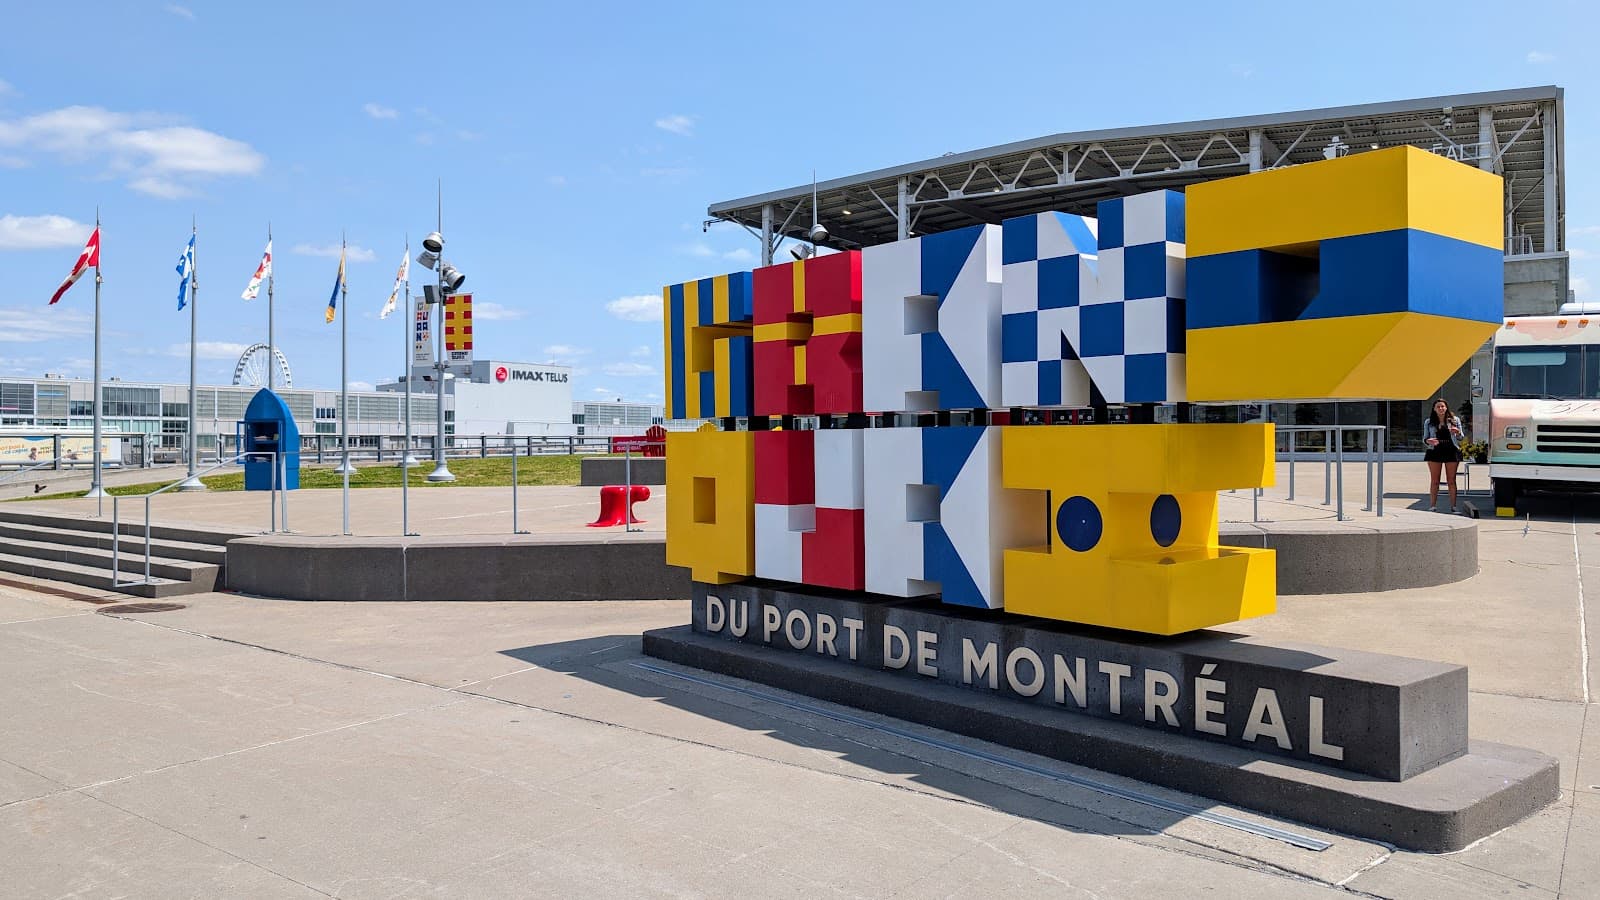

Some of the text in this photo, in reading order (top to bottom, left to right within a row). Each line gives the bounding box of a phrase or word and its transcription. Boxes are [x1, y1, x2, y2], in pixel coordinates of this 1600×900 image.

[512, 369, 569, 383] IMAX TELUS
[706, 595, 1345, 761] DU PORT DE MONTRÉAL
